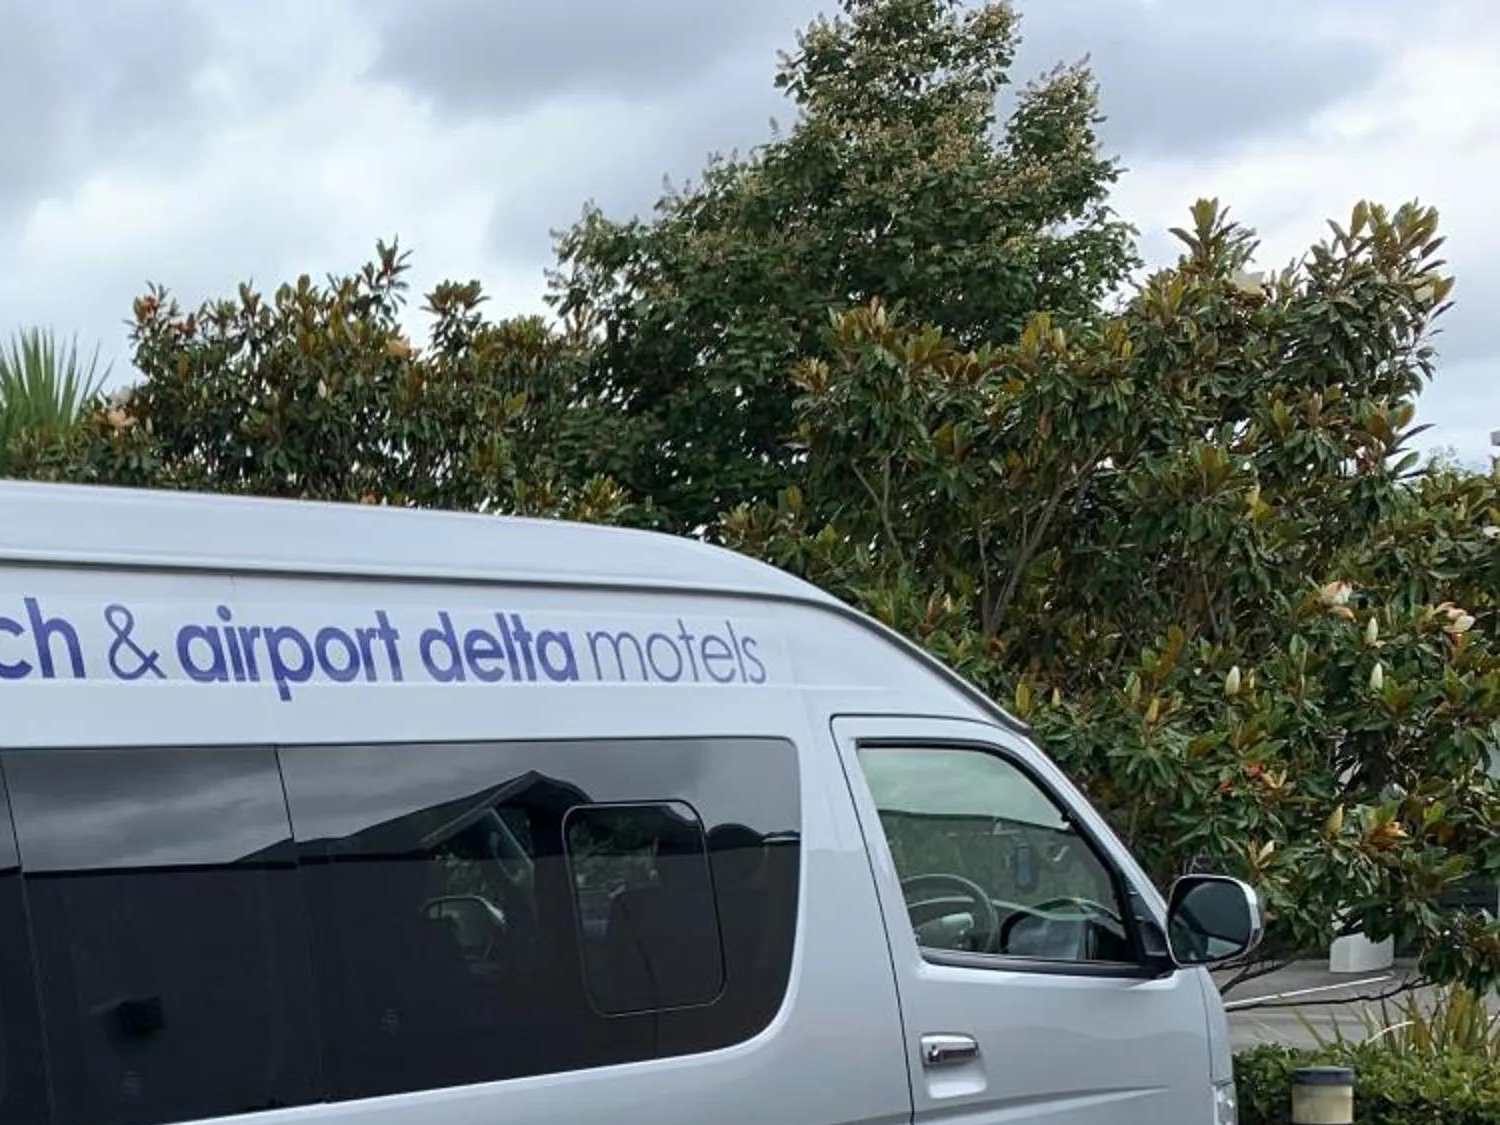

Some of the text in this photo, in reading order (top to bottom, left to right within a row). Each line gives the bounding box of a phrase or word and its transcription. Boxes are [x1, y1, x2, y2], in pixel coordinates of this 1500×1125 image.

[103, 602, 166, 682] &
[175, 605, 405, 702] airport
[419, 608, 580, 684] delta
[586, 618, 767, 684] motels
